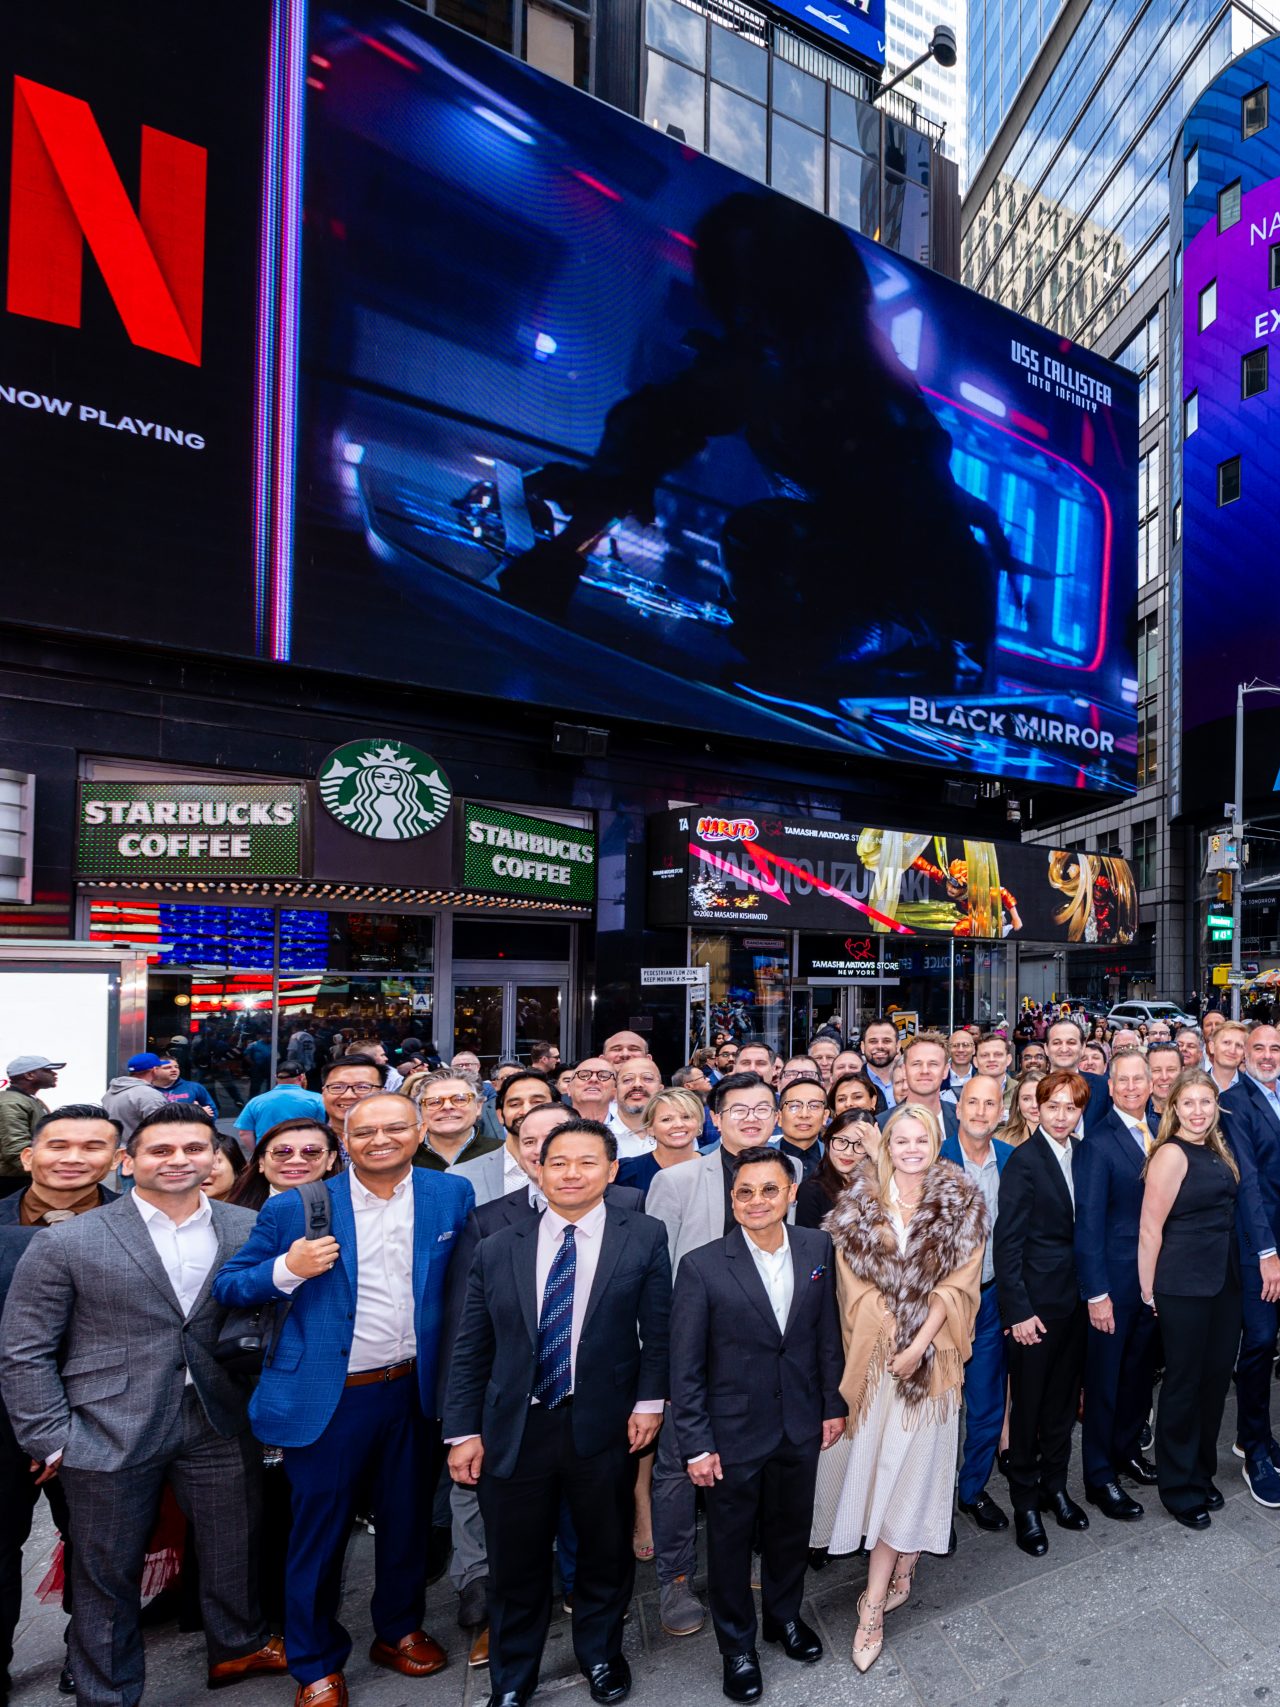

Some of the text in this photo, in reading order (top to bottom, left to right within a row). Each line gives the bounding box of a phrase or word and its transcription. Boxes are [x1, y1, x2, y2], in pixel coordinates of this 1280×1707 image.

[6, 75, 207, 367] N
[1011, 339, 1112, 407] USS CALLISTER
[1028, 372, 1097, 413] INTO INFINITY
[0, 384, 206, 450] NOW PLAYING
[908, 695, 1115, 753] BLACK MIRROR
[84, 800, 296, 826] STARBUCKS
[468, 820, 593, 864] STARBUCKS
[696, 816, 760, 841] NARUTO
[784, 826, 818, 837] TAMASHII
[118, 833, 251, 858] COFFEE
[492, 854, 571, 885] COFFEE
[739, 912, 768, 920] KISHIMOTO
[844, 961, 875, 969] NATIONS
[876, 962, 900, 970] STORE
[416, 995, 427, 1007] A
